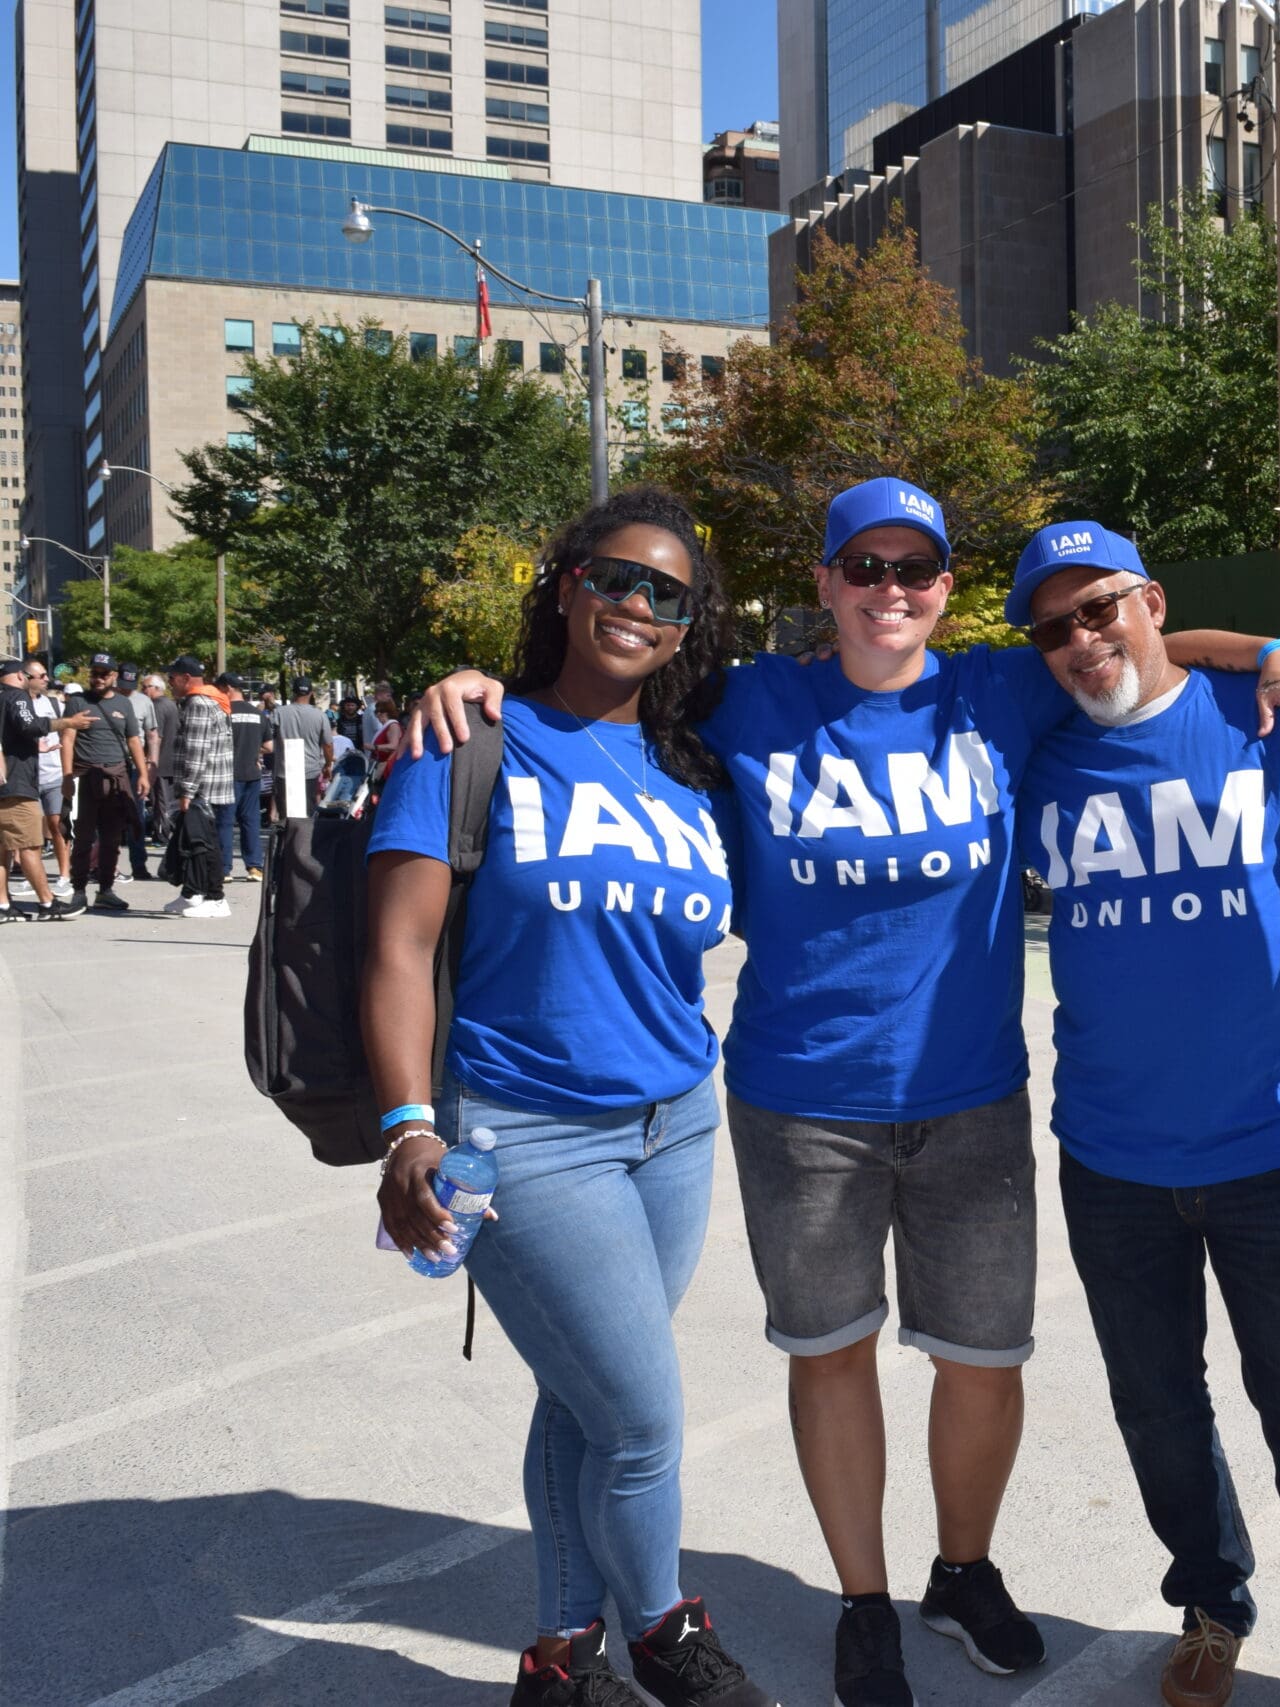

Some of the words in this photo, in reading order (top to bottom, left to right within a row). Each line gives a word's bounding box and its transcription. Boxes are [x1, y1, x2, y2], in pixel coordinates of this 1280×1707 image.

[899, 491, 935, 521] IAM
[905, 506, 933, 525] UNION
[1050, 532, 1093, 552] IAM
[1057, 545, 1091, 557] UNION
[765, 730, 999, 839] IAM
[508, 776, 728, 880] IAM
[1041, 769, 1265, 889] IAM
[790, 838, 991, 885] UNION
[1071, 887, 1248, 928] UNION
